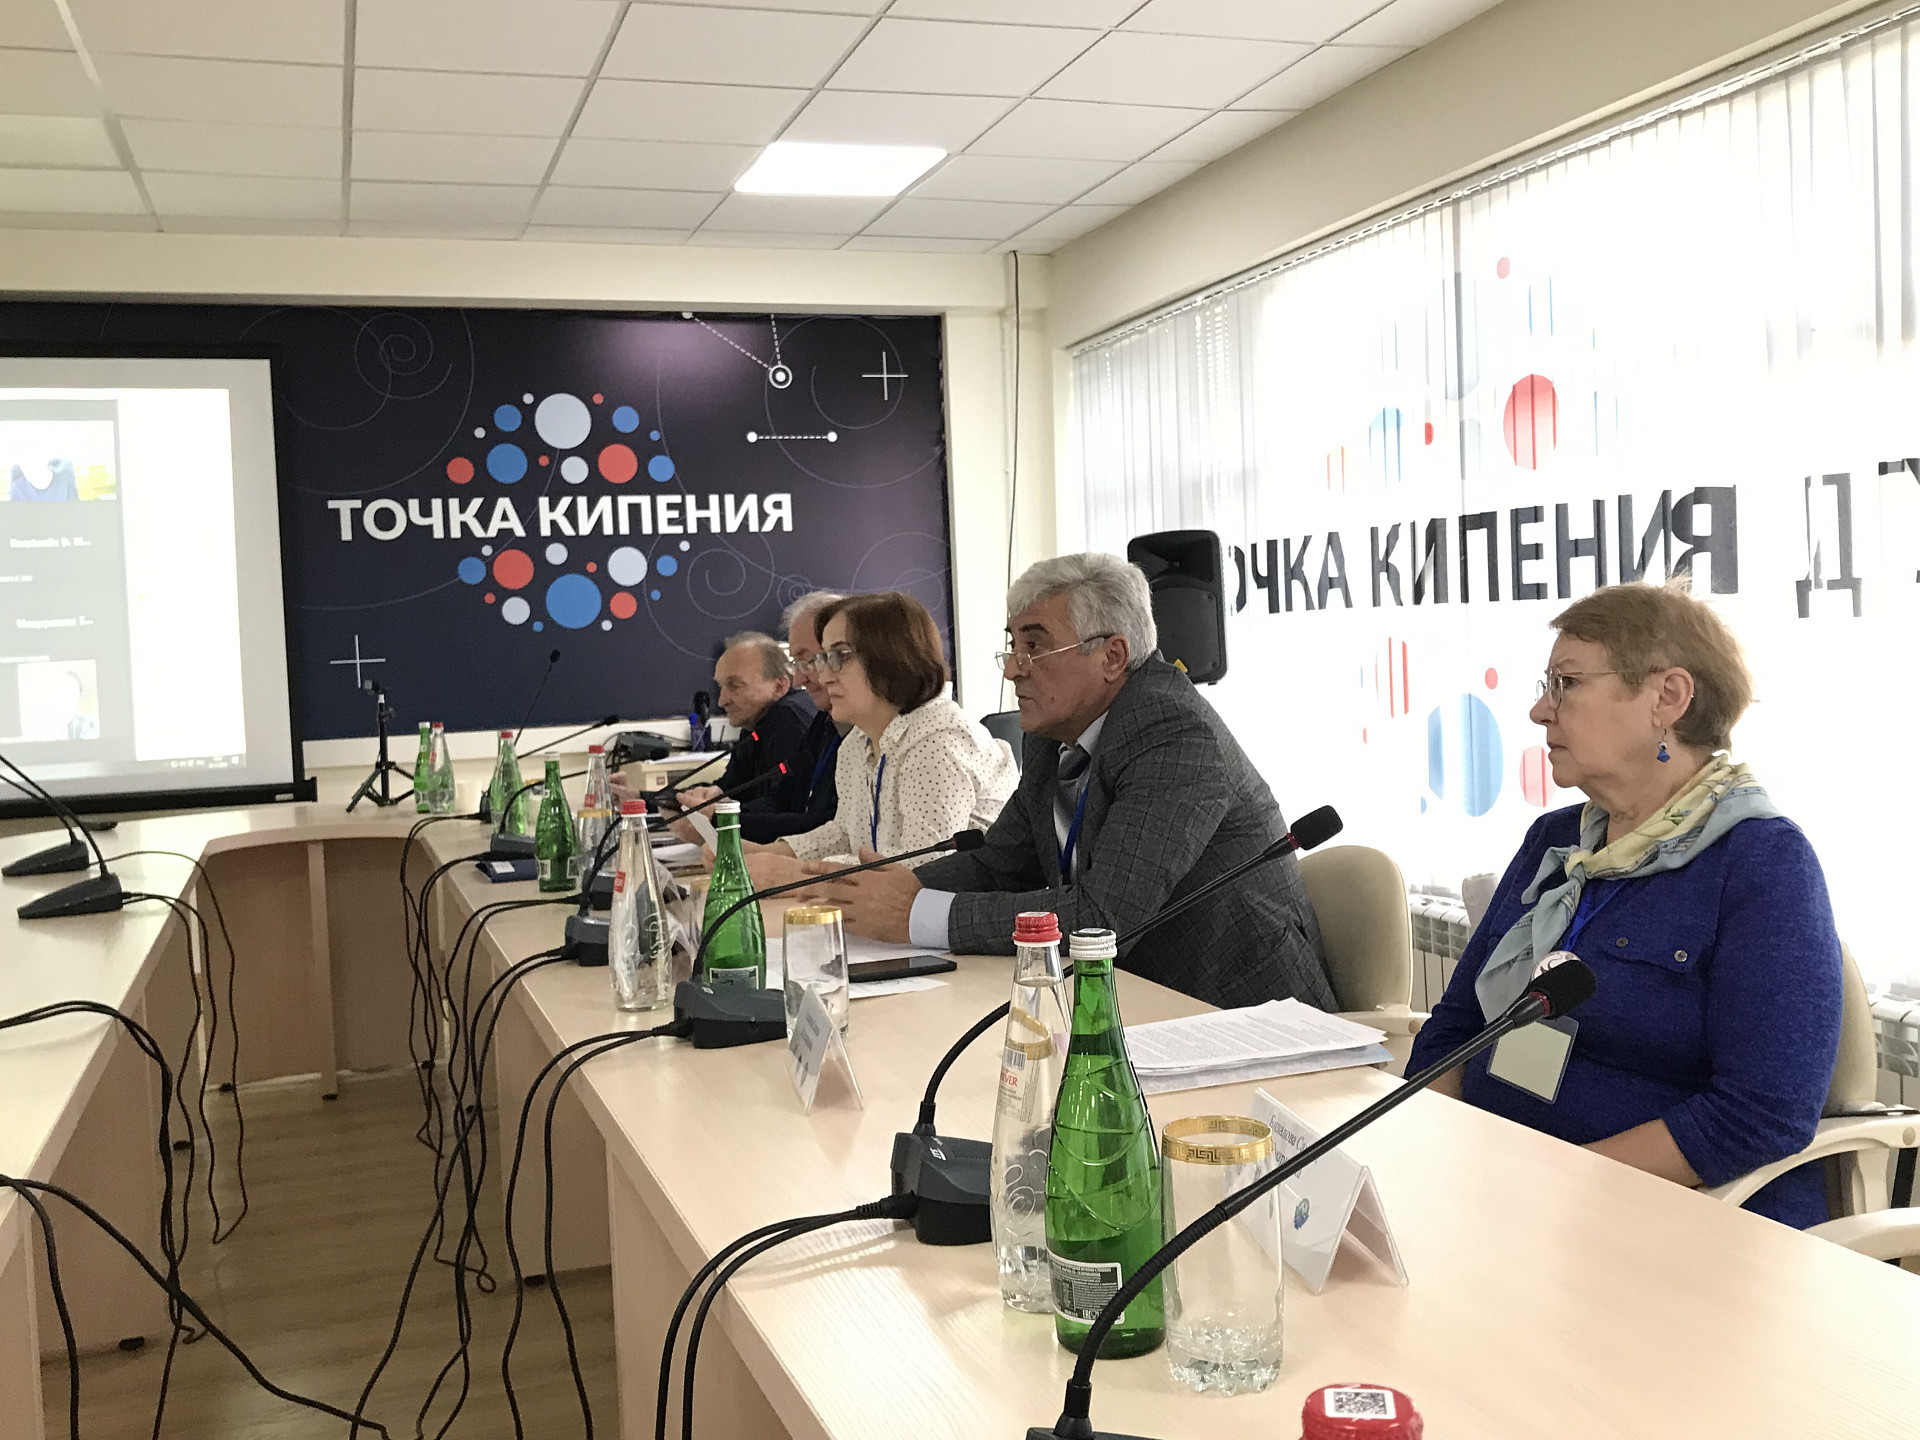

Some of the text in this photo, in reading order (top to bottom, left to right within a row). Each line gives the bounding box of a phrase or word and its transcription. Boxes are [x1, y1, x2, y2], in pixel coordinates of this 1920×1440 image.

[327, 493, 794, 542] ТОЧКА КИПЕНИЯ
[1227, 531, 1353, 615] ОЧКА
[1370, 484, 1739, 607] КИПЕНИЯ
